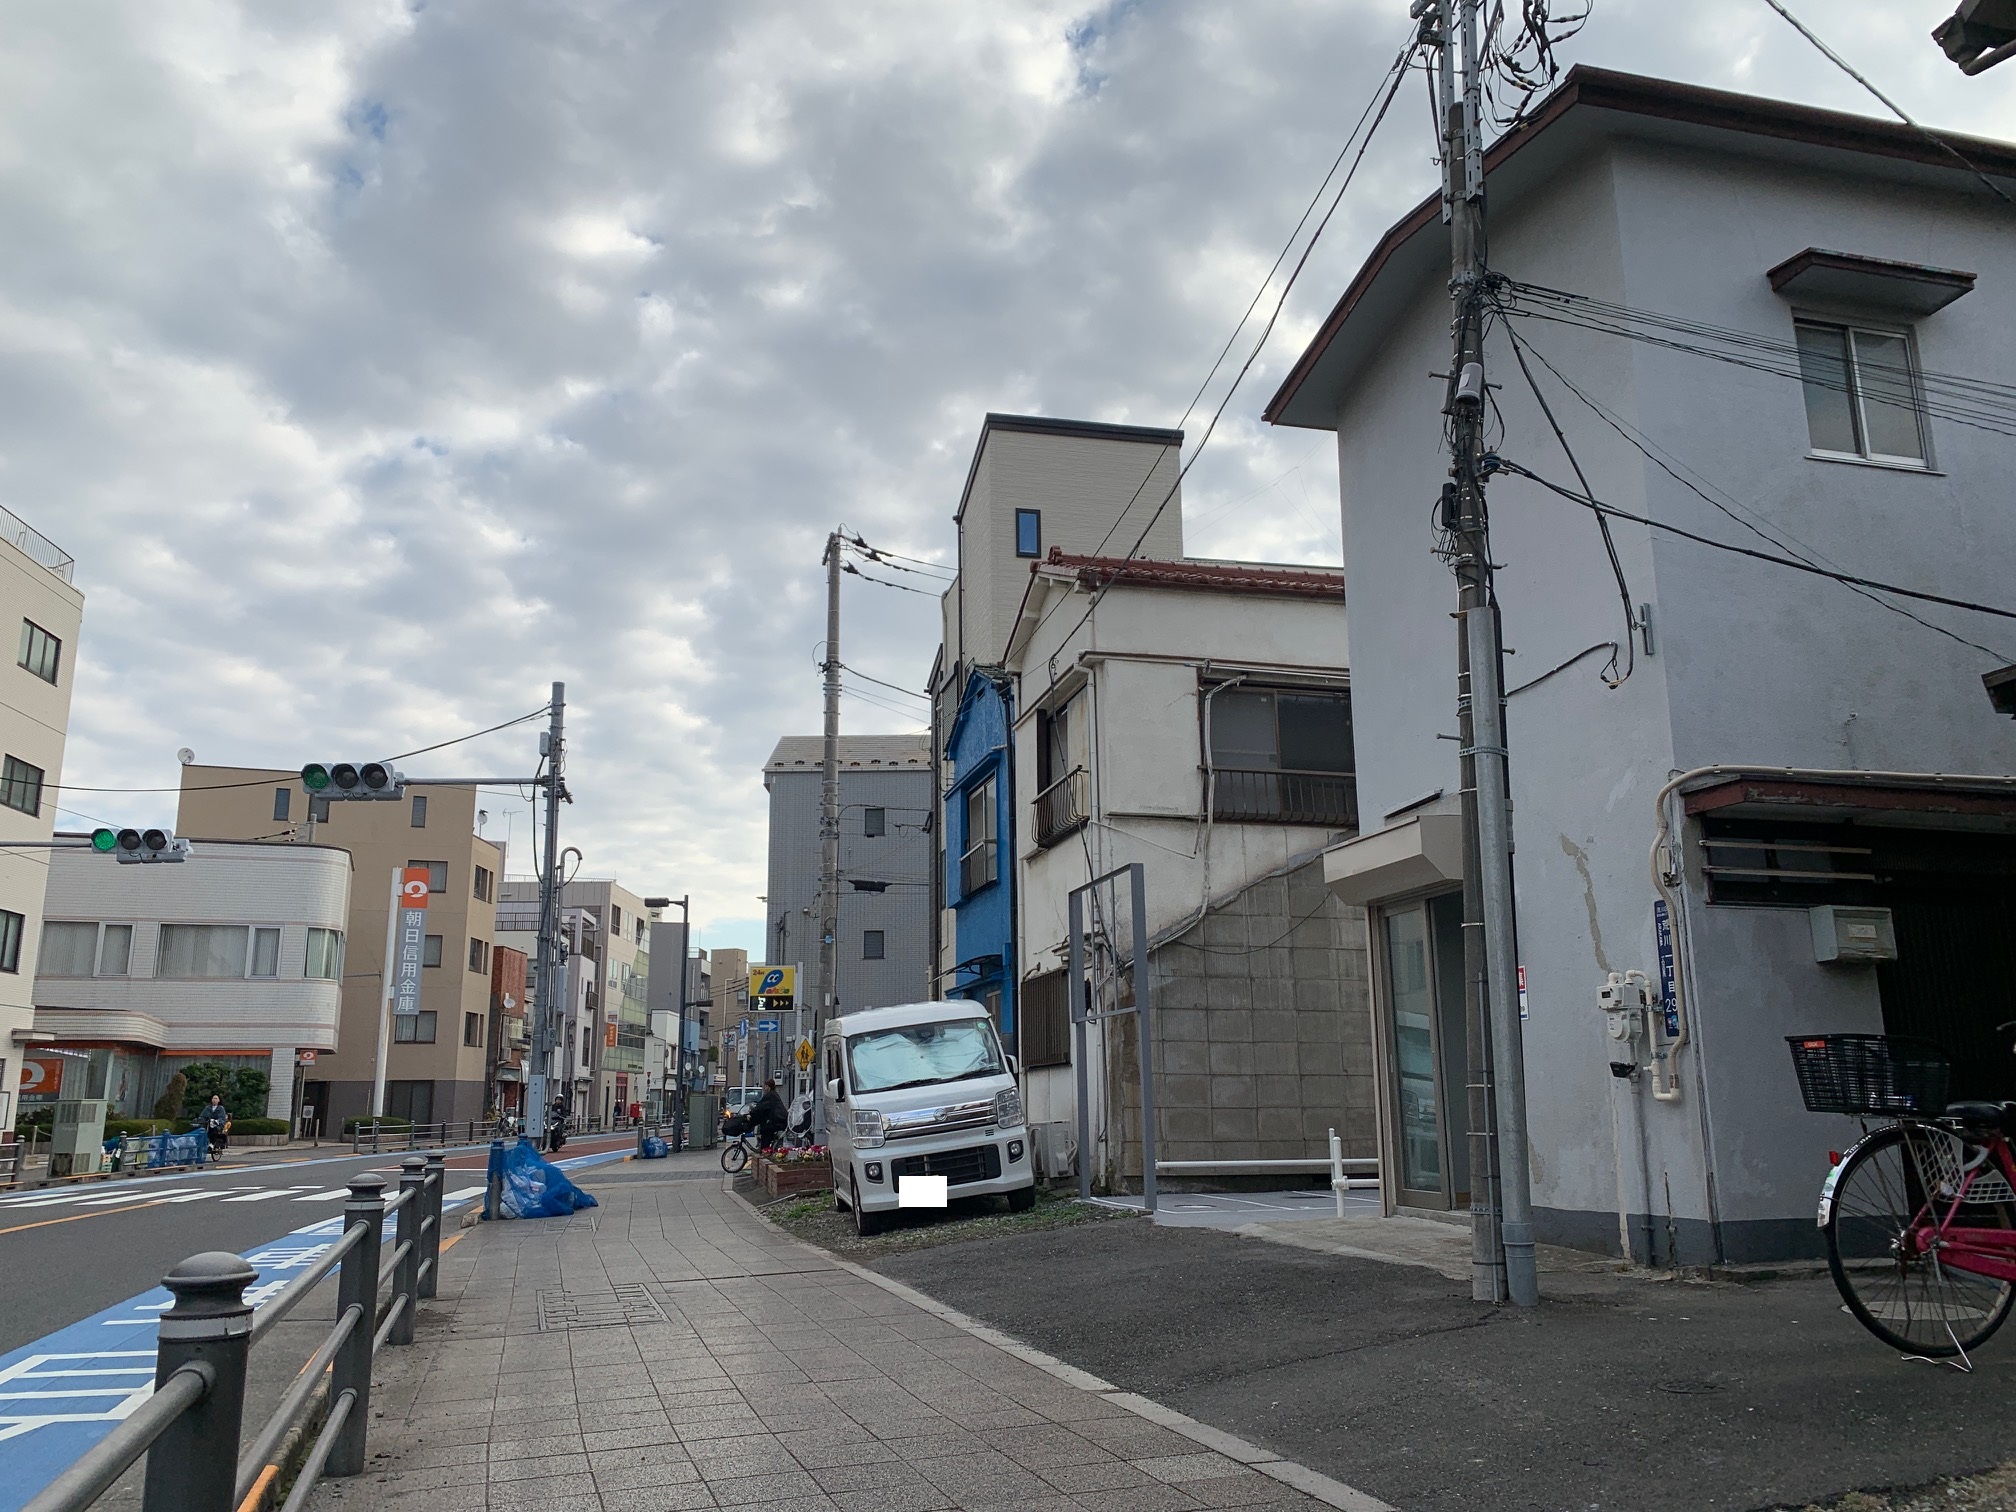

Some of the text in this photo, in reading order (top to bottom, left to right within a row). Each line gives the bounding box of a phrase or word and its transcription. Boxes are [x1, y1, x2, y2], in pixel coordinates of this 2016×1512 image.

[397, 911, 422, 1011] 朝日信用金庫
[1665, 997, 1678, 1013] 29
